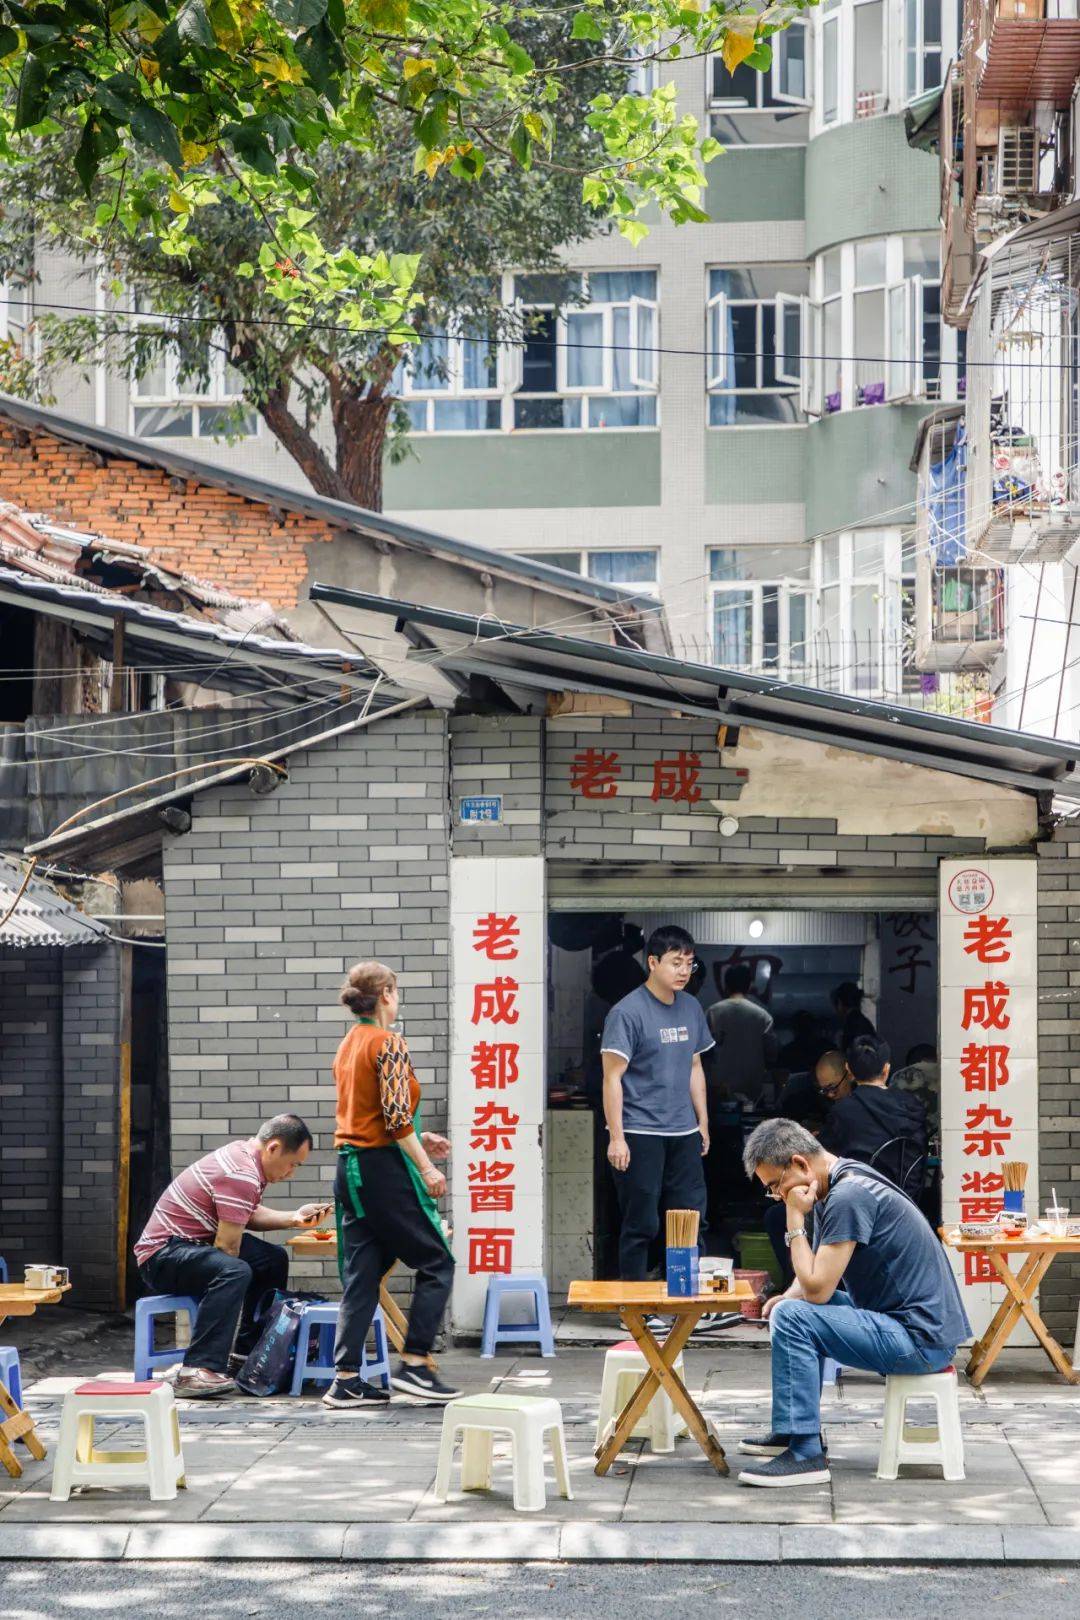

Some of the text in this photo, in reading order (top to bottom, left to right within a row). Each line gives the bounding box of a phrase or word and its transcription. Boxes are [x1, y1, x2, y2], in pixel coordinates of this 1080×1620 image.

[467, 912, 520, 1275] 老成都杂酱面
